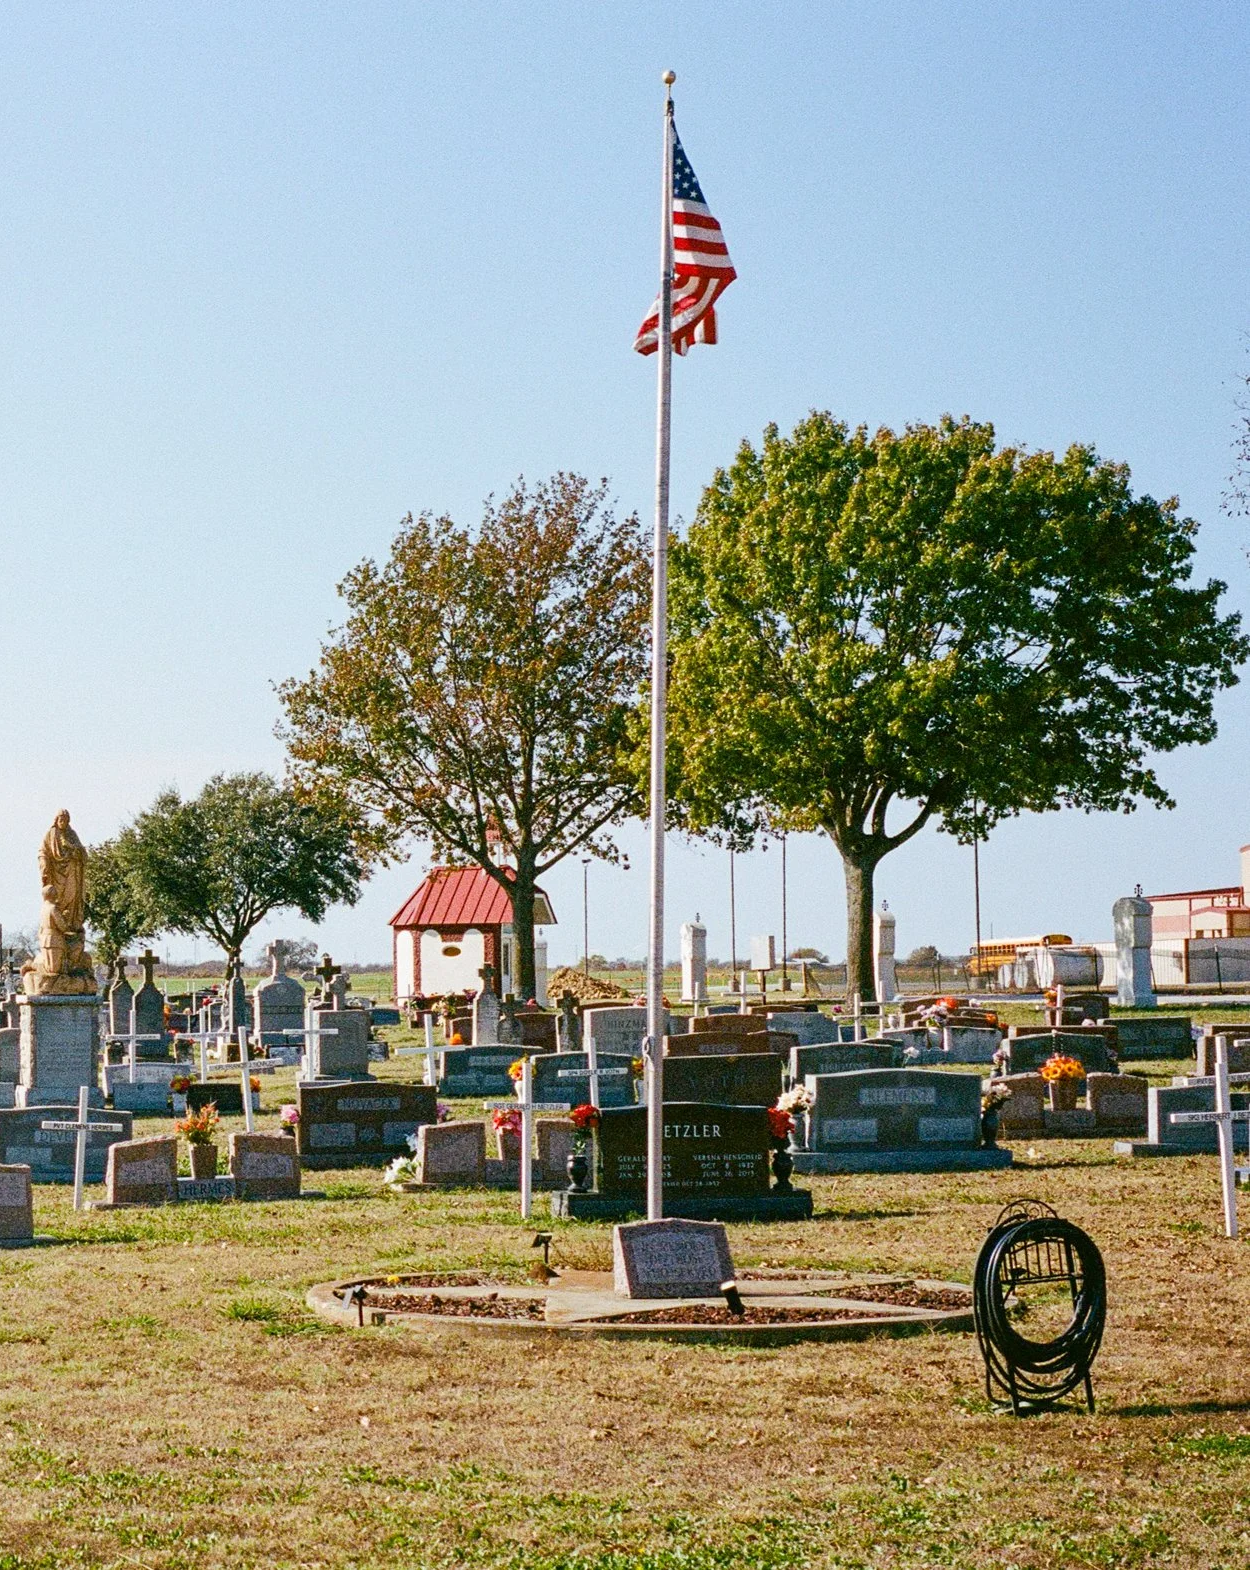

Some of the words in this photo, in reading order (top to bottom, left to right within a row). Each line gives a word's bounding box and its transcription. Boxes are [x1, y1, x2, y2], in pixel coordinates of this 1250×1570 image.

[606, 1019, 647, 1029] HINZMA
[663, 1125, 722, 1138] ETZLER
[184, 1183, 233, 1194] HERMES
